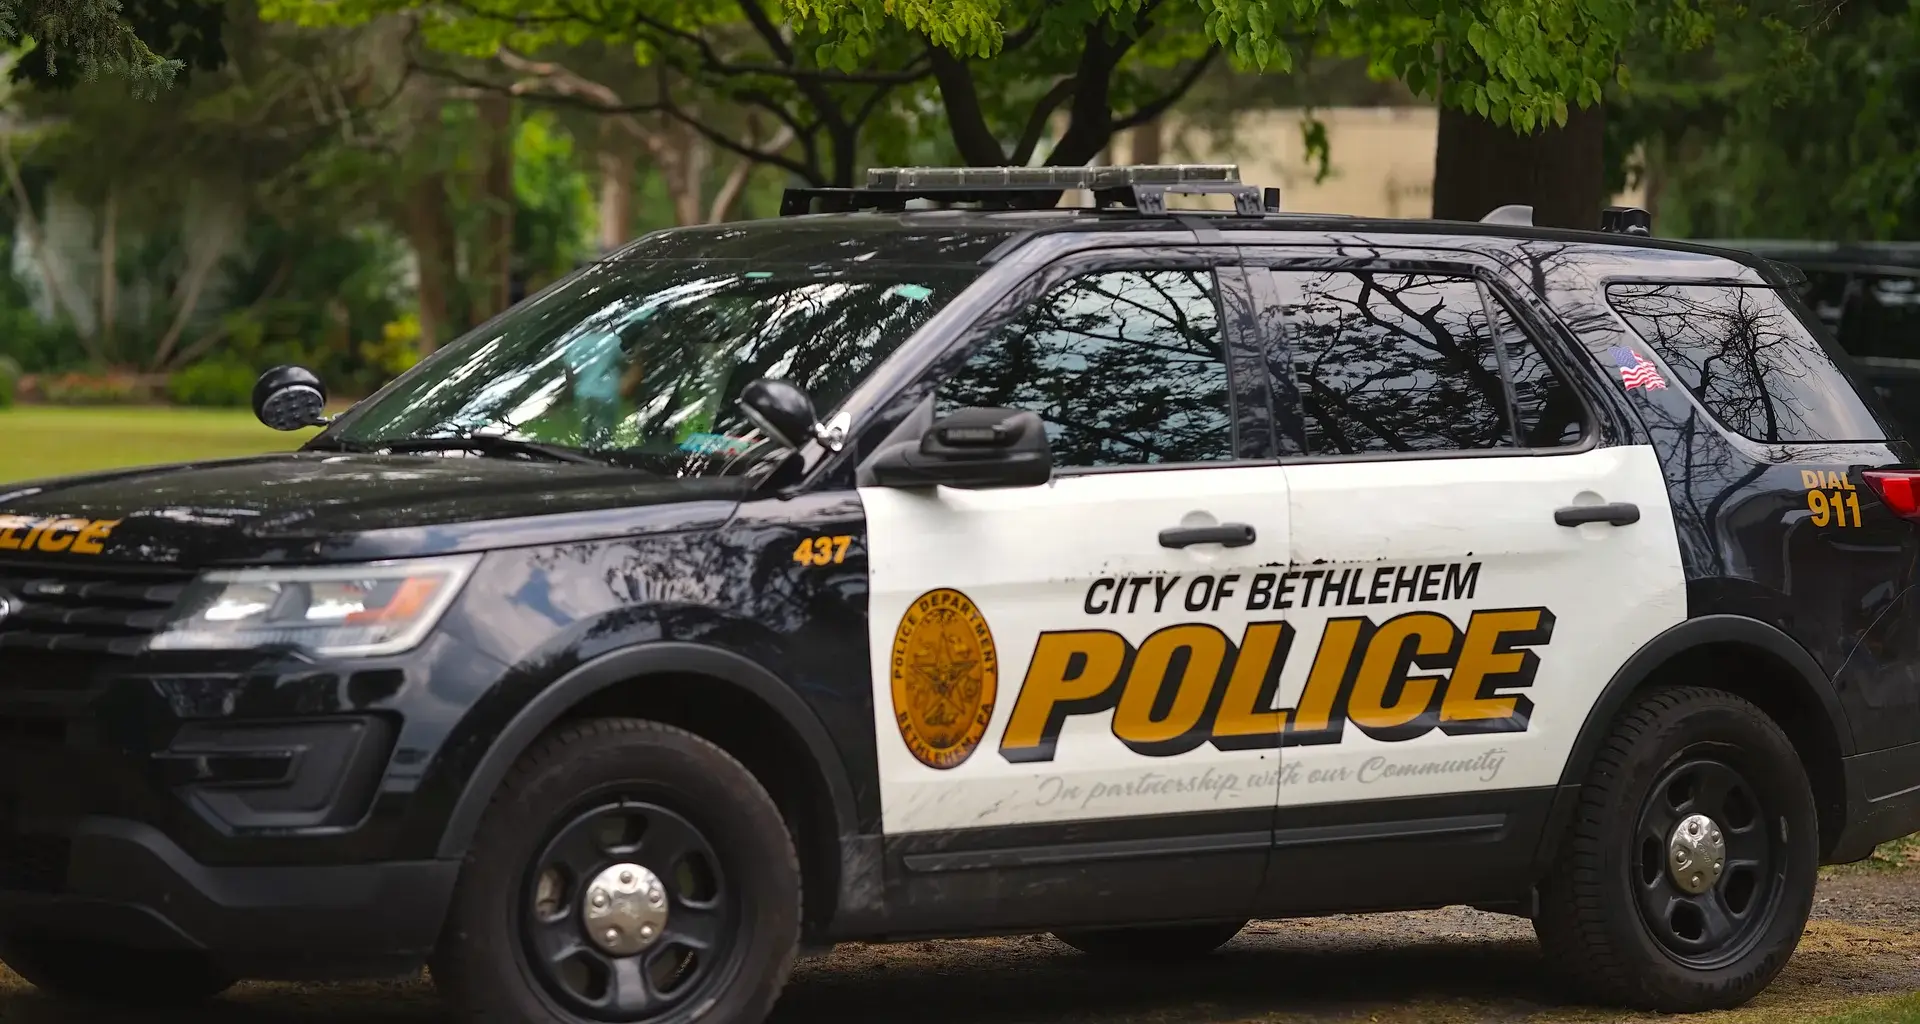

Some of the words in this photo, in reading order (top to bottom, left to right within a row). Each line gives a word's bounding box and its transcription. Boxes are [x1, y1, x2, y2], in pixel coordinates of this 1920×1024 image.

[1801, 469, 1856, 490] DIAL
[1807, 489, 1862, 528] 911
[0, 514, 124, 554] LICE
[793, 535, 852, 567] 437
[1084, 576, 1181, 614] CITY
[1184, 574, 1240, 612] OF
[1245, 562, 1482, 611] BETHLEHEM
[894, 615, 920, 679] POLICE
[919, 593, 994, 674] DEPARTMENT
[998, 606, 1556, 763] POLICE
[977, 703, 995, 725] PA
[1035, 775, 1081, 807] In
[1080, 767, 1242, 810] partnership
[1246, 761, 1304, 789] with
[1308, 766, 1353, 785] our
[1357, 747, 1508, 784] Community
